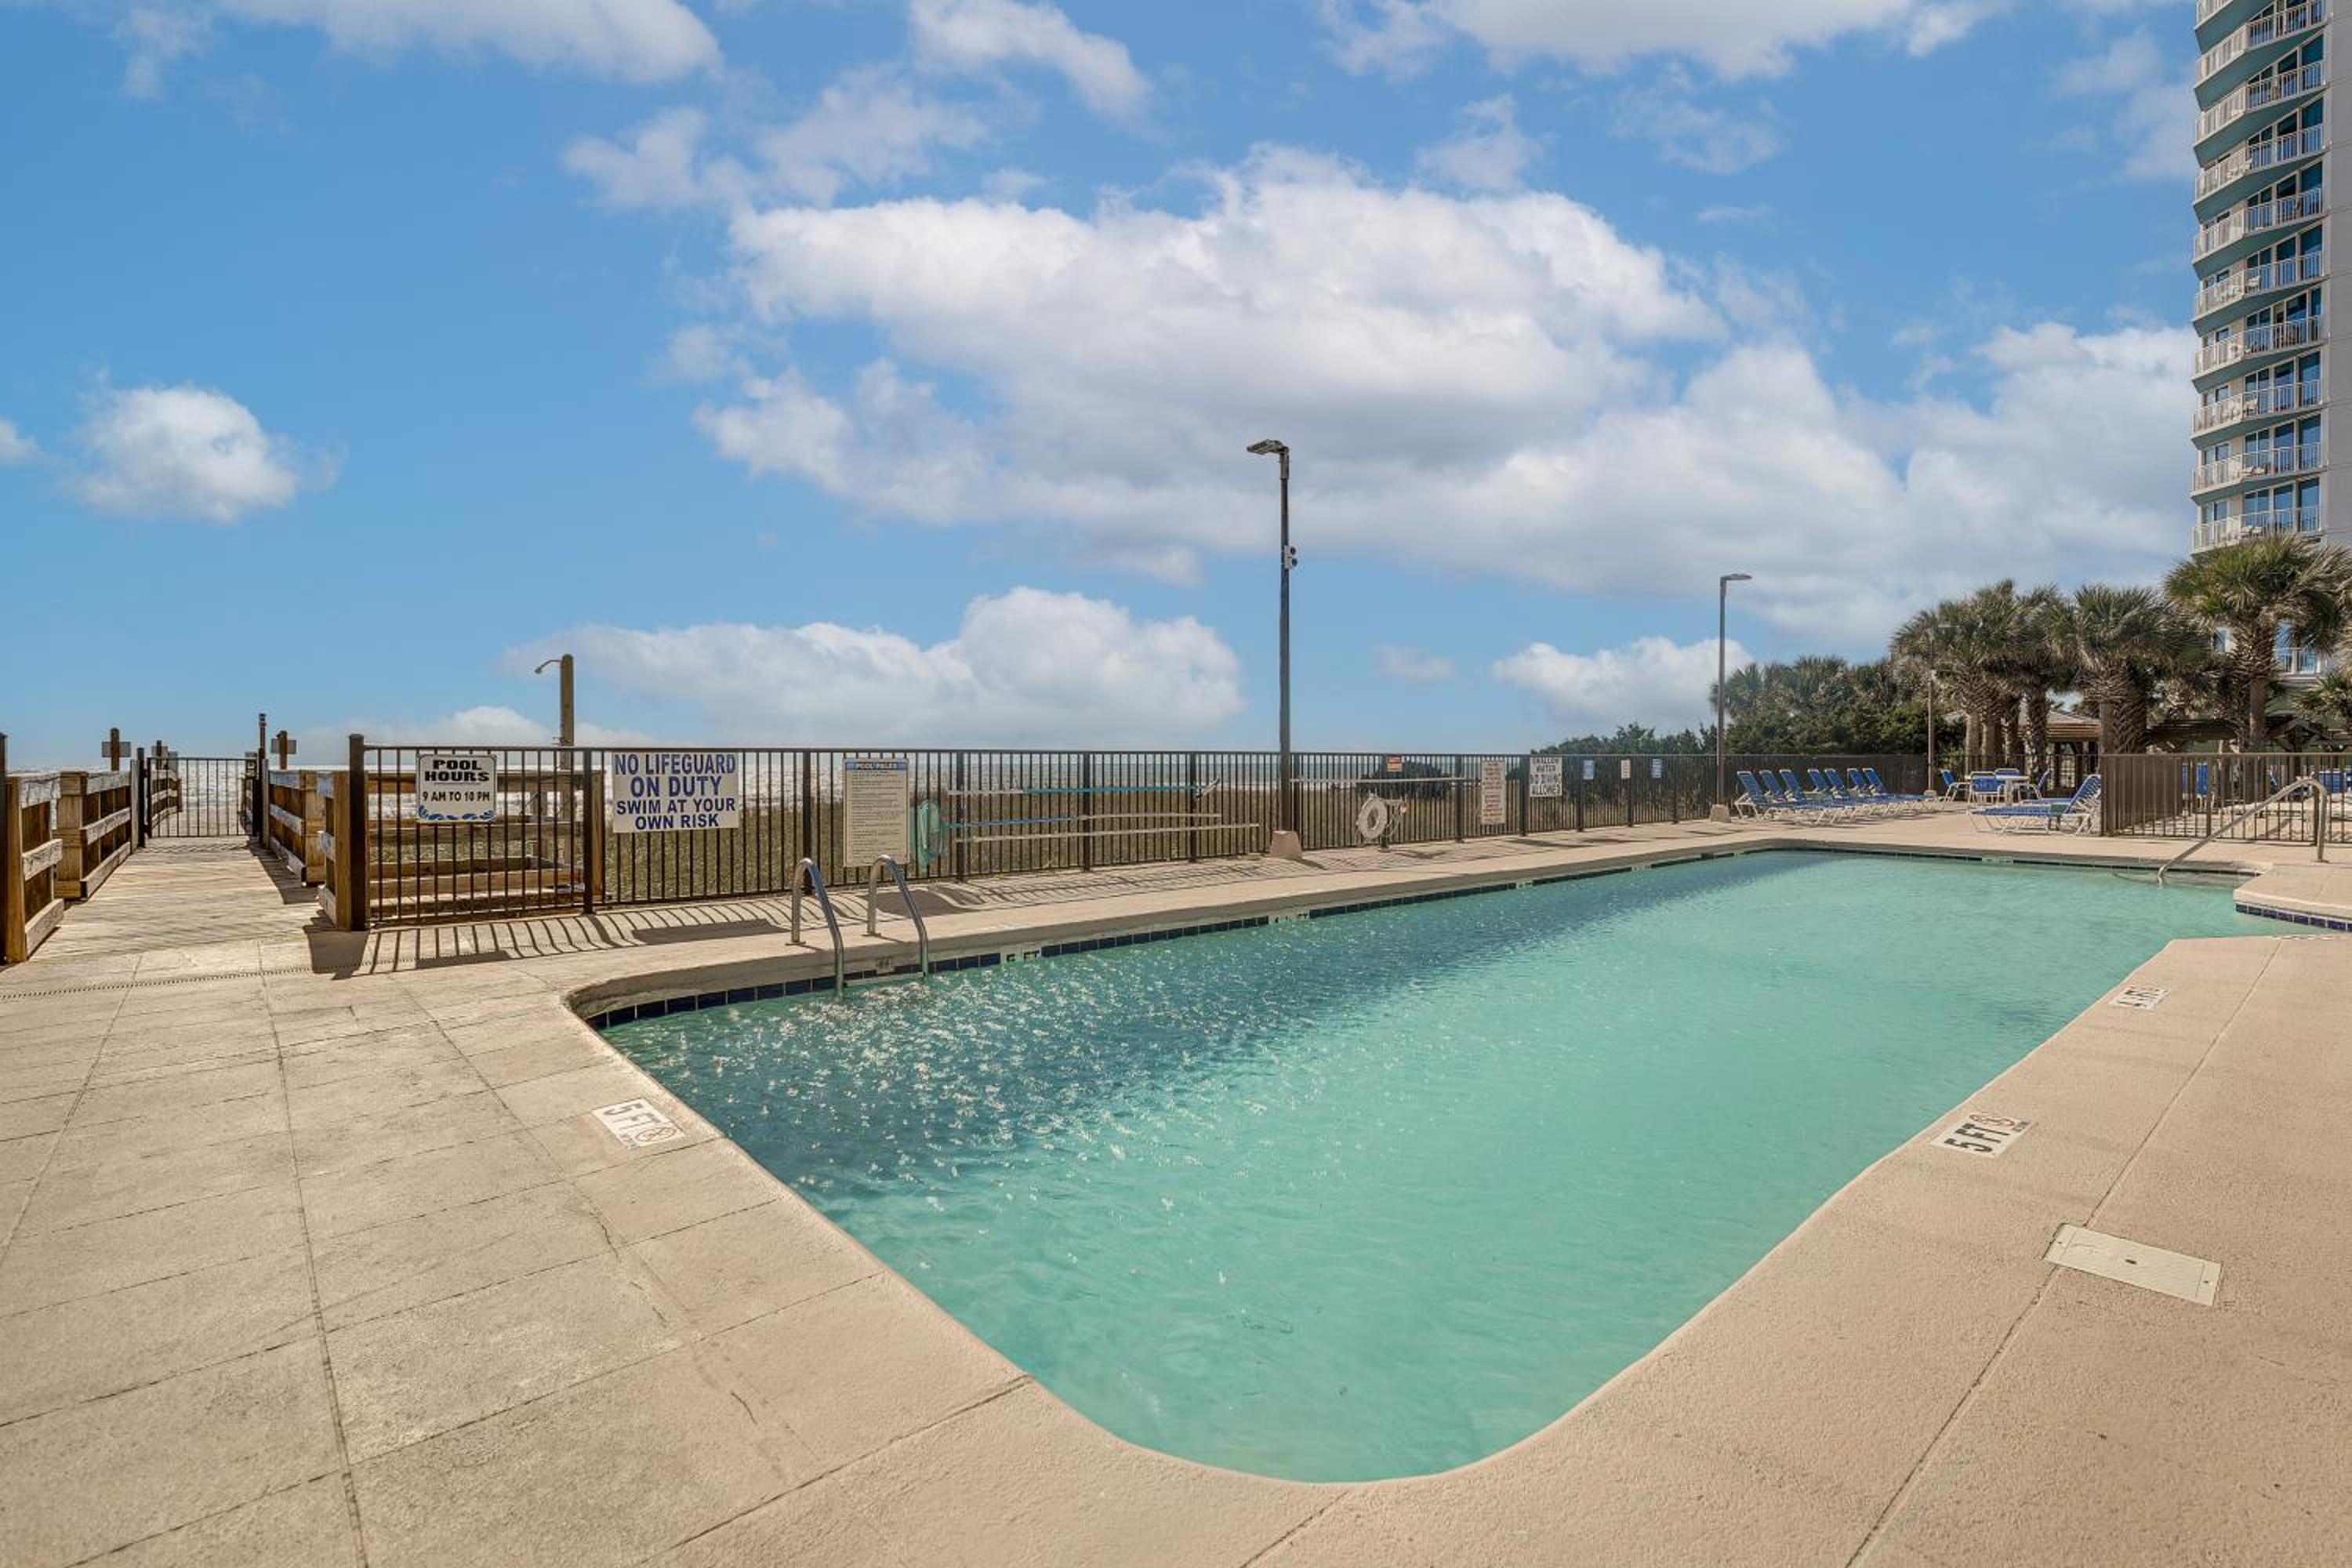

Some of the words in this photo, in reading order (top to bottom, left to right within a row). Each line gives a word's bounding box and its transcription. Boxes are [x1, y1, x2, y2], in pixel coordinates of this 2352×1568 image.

[433, 760, 482, 770] POOL
[614, 753, 639, 775] NO
[645, 753, 736, 775] LIFEGUARD
[424, 771, 490, 782] HOURS
[630, 775, 660, 797] ON
[668, 775, 722, 797] DUTY
[423, 791, 429, 801] 9
[430, 791, 446, 801] AM
[449, 791, 461, 801] TO
[464, 791, 474, 801] 10
[477, 791, 490, 801] PM
[616, 799, 661, 815] SWIM
[667, 798, 688, 814] AT
[693, 797, 735, 813] YOUR
[635, 815, 673, 830] OWN
[681, 813, 719, 829] RISK
[1954, 1123, 2011, 1144] FT
[1944, 1138, 1994, 1152] 5
